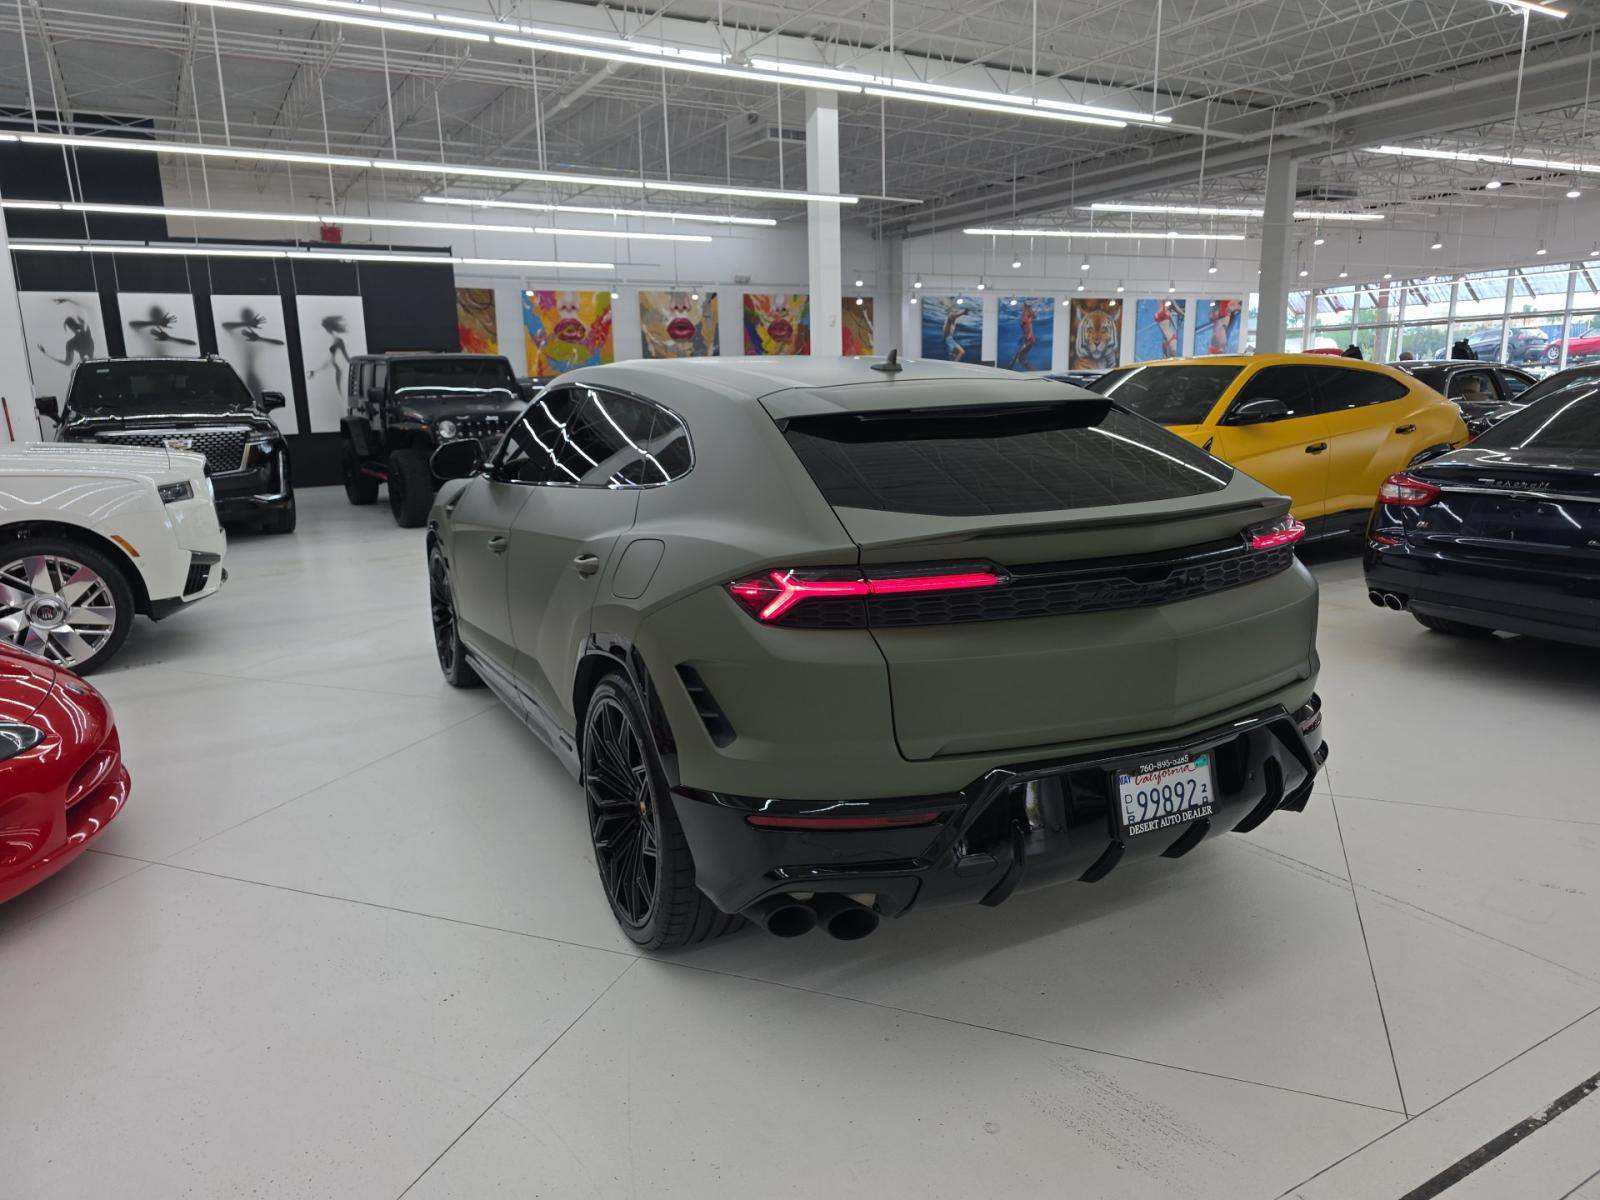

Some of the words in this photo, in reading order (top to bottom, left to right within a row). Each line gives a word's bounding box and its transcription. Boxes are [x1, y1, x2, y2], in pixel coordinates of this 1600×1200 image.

[1135, 764, 1196, 786] California
[1137, 779, 1197, 822] 99892
[1129, 819, 1159, 836] DESERT
[1160, 813, 1181, 828] AUTO
[1182, 805, 1213, 821] DEALER
